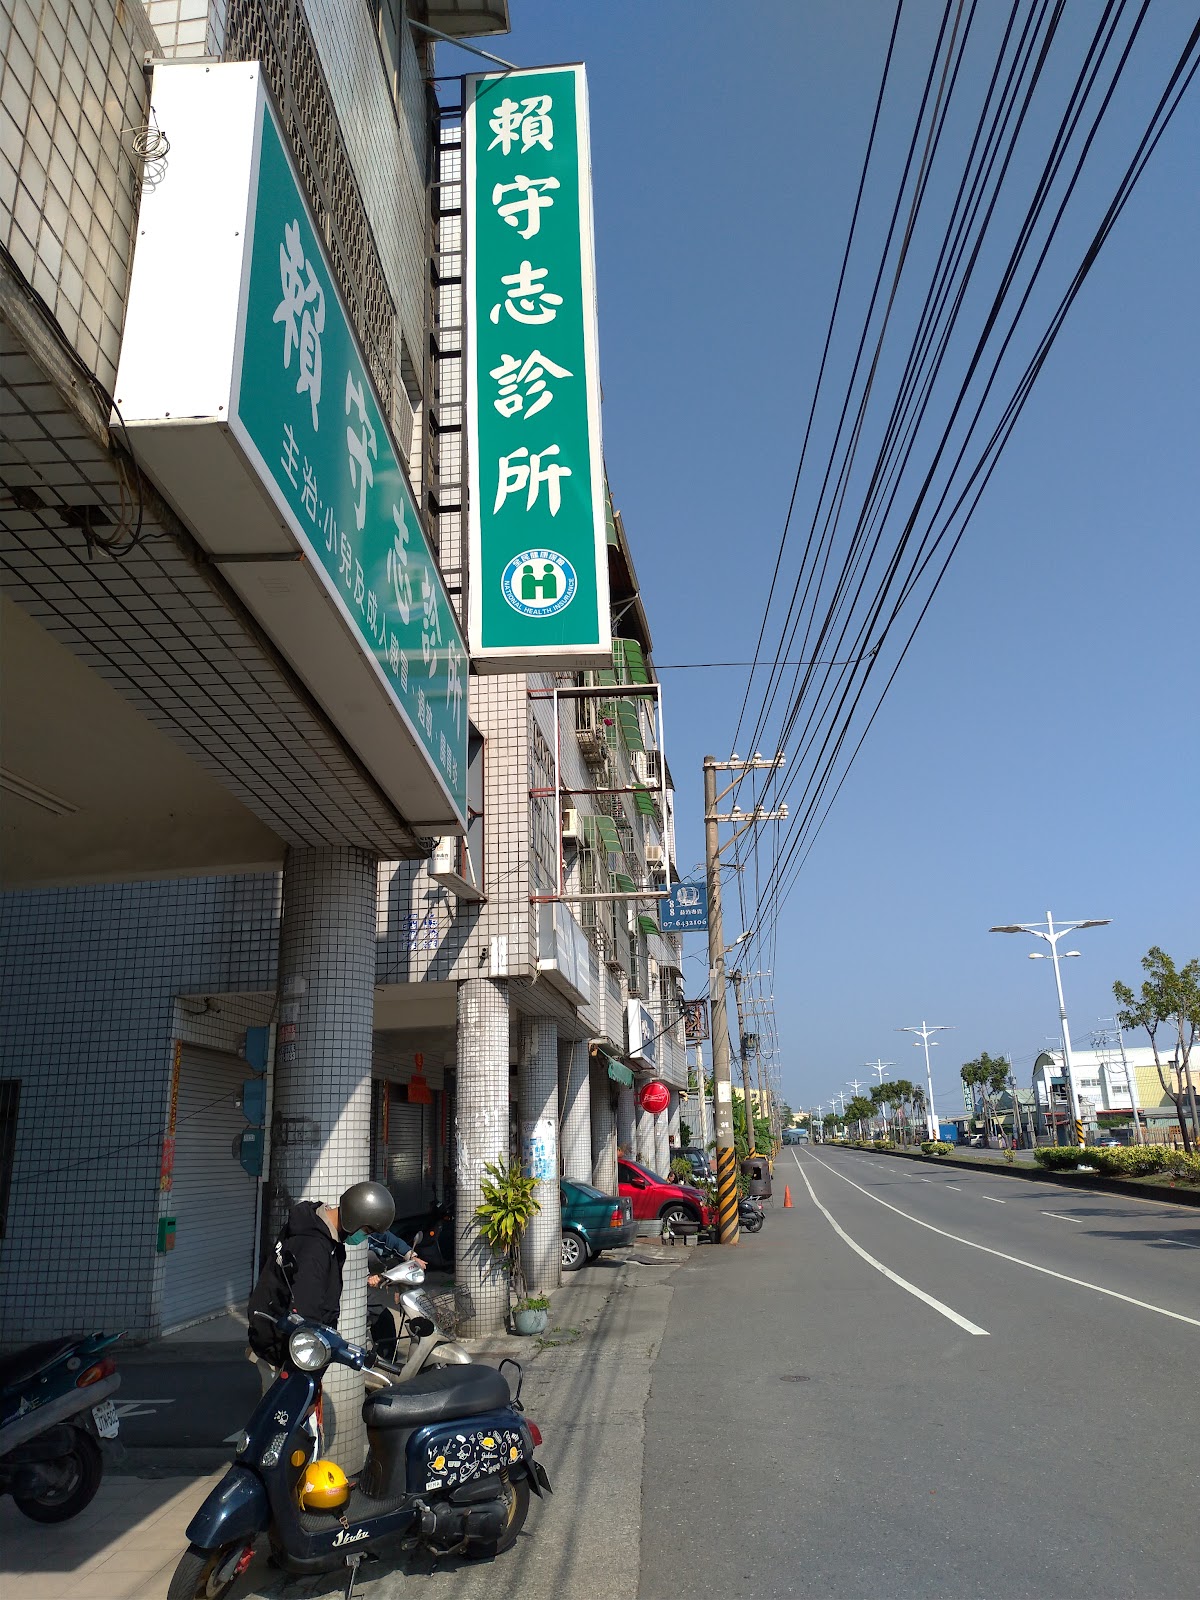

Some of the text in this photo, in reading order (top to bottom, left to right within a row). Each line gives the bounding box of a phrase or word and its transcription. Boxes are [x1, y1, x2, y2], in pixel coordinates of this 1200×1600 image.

[275, 218, 463, 742] 賴守志診所
[487, 94, 573, 517] 賴守志診所
[504, 577, 575, 615] NATIONAL HEALTH INSURANCE
